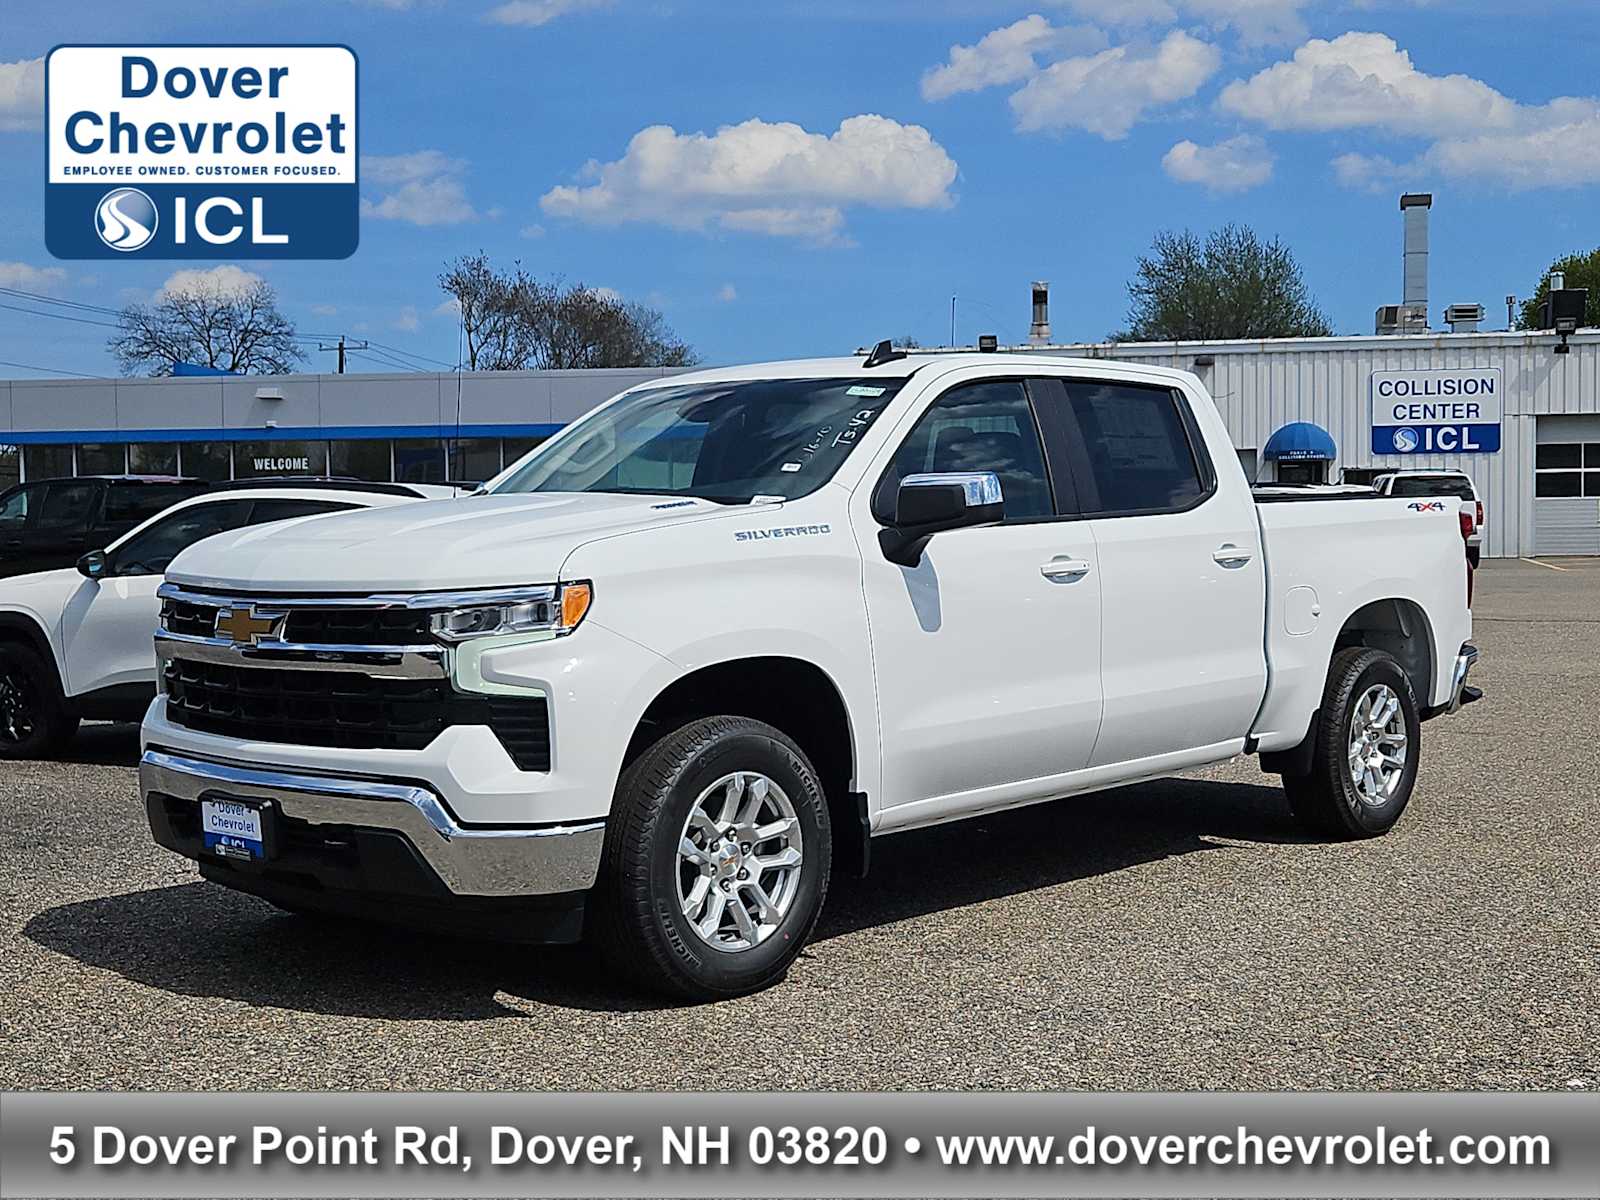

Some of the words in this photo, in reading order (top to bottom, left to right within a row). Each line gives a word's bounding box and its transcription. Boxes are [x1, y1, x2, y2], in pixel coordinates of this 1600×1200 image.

[1379, 378, 1494, 397] COLLISION
[1393, 403, 1480, 420] CENTER
[1425, 427, 1480, 451] ICL
[254, 457, 309, 470] WELCOME
[735, 524, 831, 542] SILVERADO
[218, 801, 245, 817] Dover
[211, 815, 255, 833] Chevrolet
[657, 898, 702, 968] MICHELI
